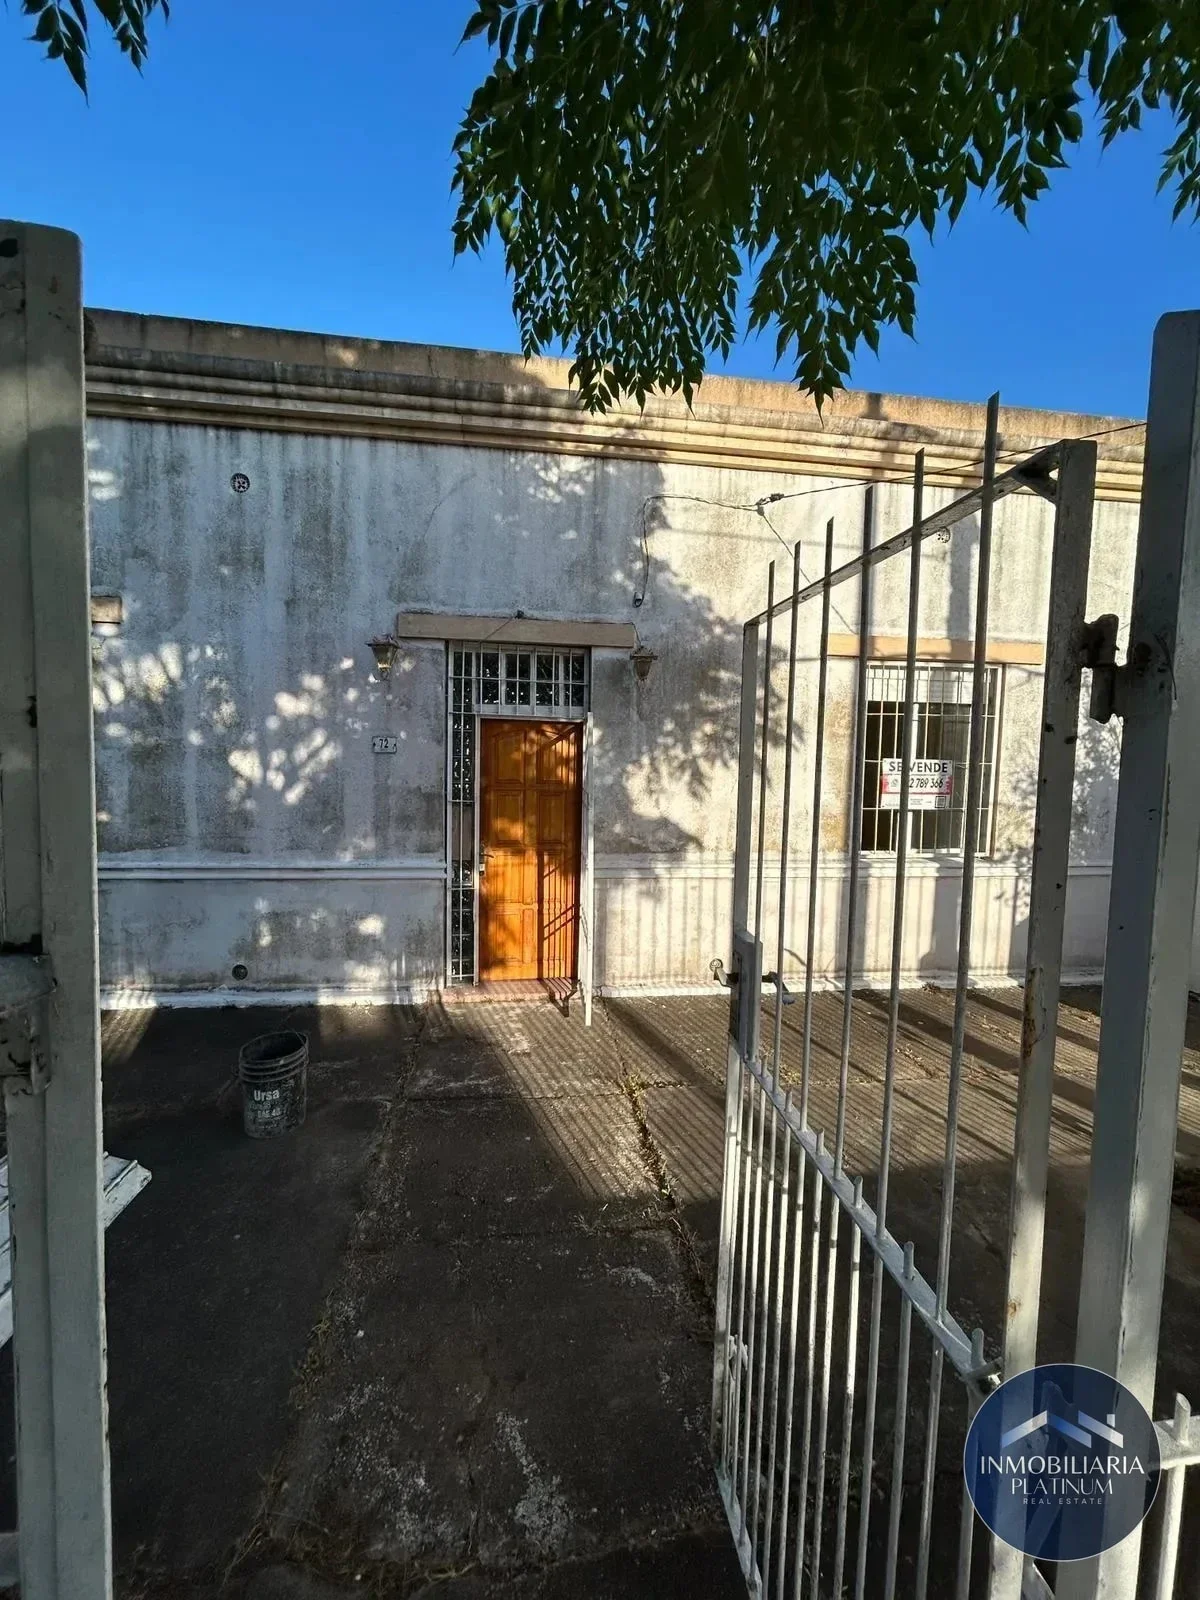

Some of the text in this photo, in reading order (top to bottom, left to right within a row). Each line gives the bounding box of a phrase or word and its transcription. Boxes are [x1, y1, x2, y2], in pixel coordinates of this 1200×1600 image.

[379, 738, 389, 748] 72
[889, 761, 948, 773] SE VENDE
[915, 778, 929, 788] 789
[254, 1089, 280, 1101] Ursa
